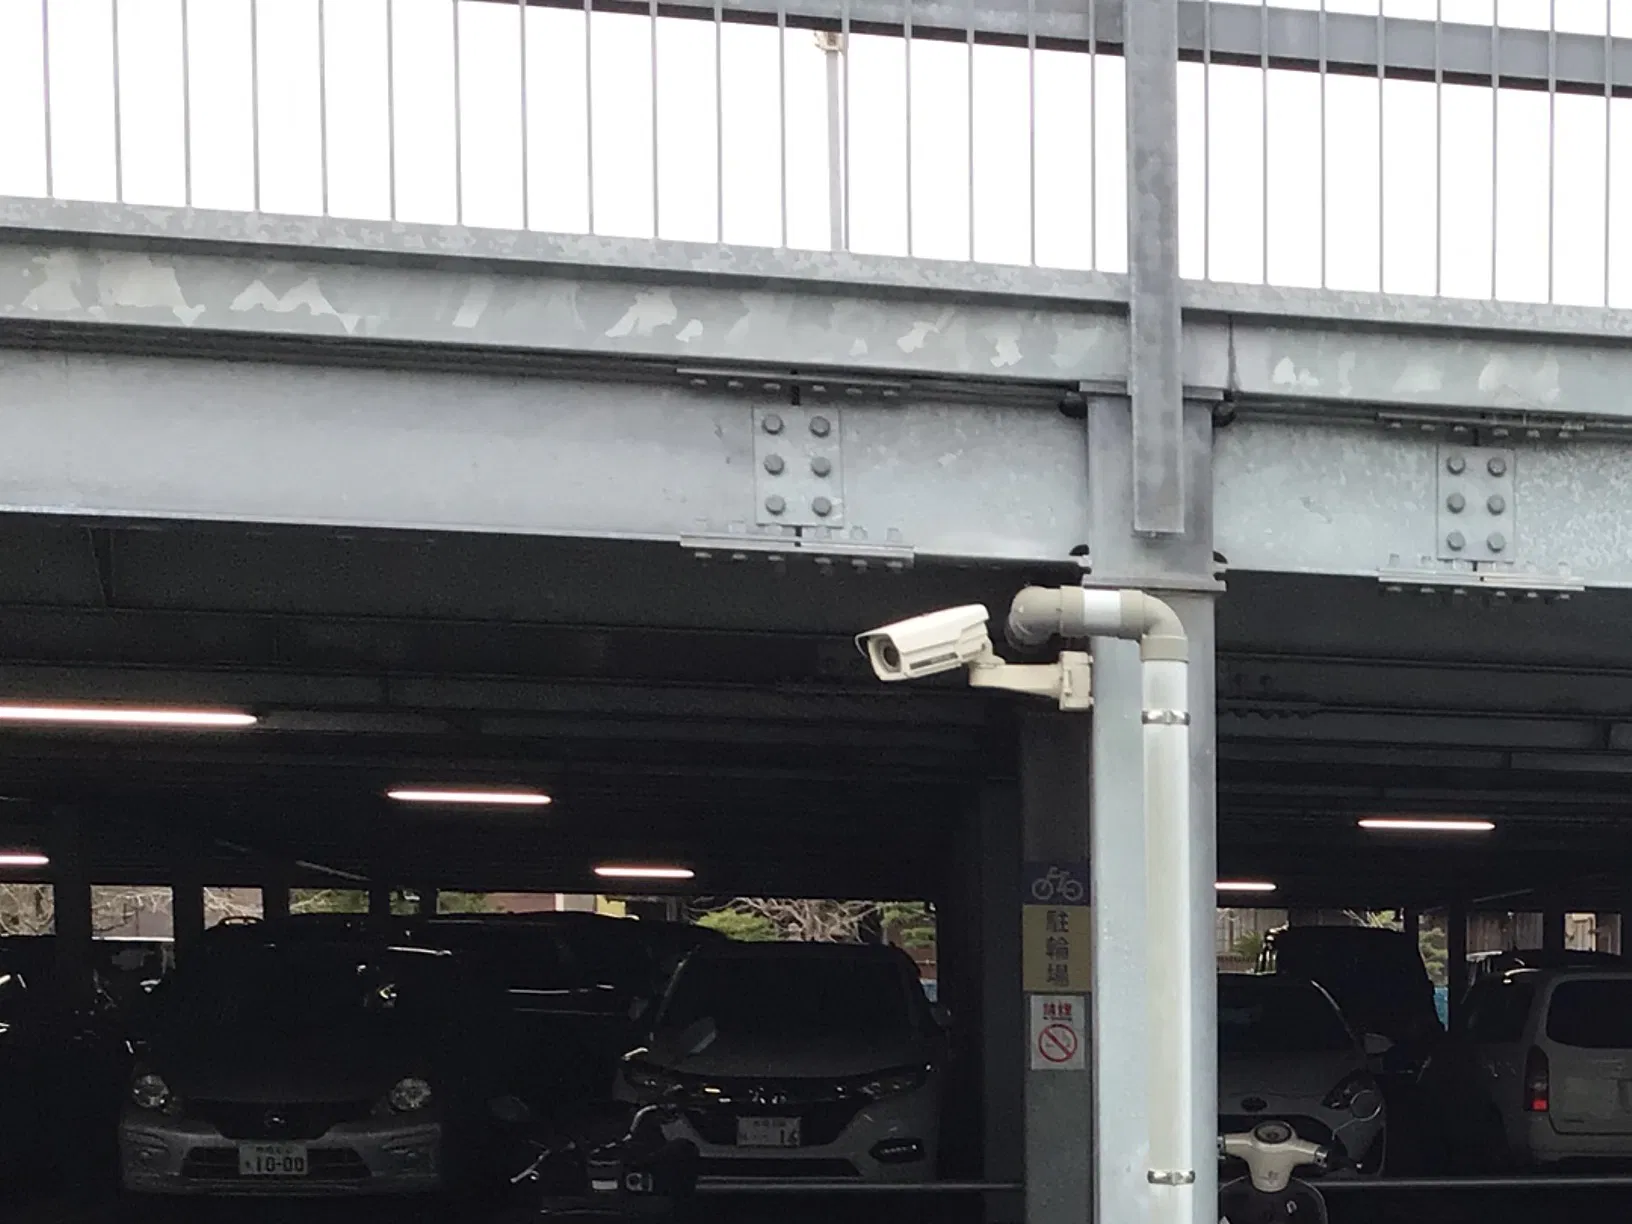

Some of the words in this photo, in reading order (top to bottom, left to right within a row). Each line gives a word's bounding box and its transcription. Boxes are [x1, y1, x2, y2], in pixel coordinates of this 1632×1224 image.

[1045, 909, 1070, 987] 駐輪場
[256, 1156, 304, 1172] 10-00
